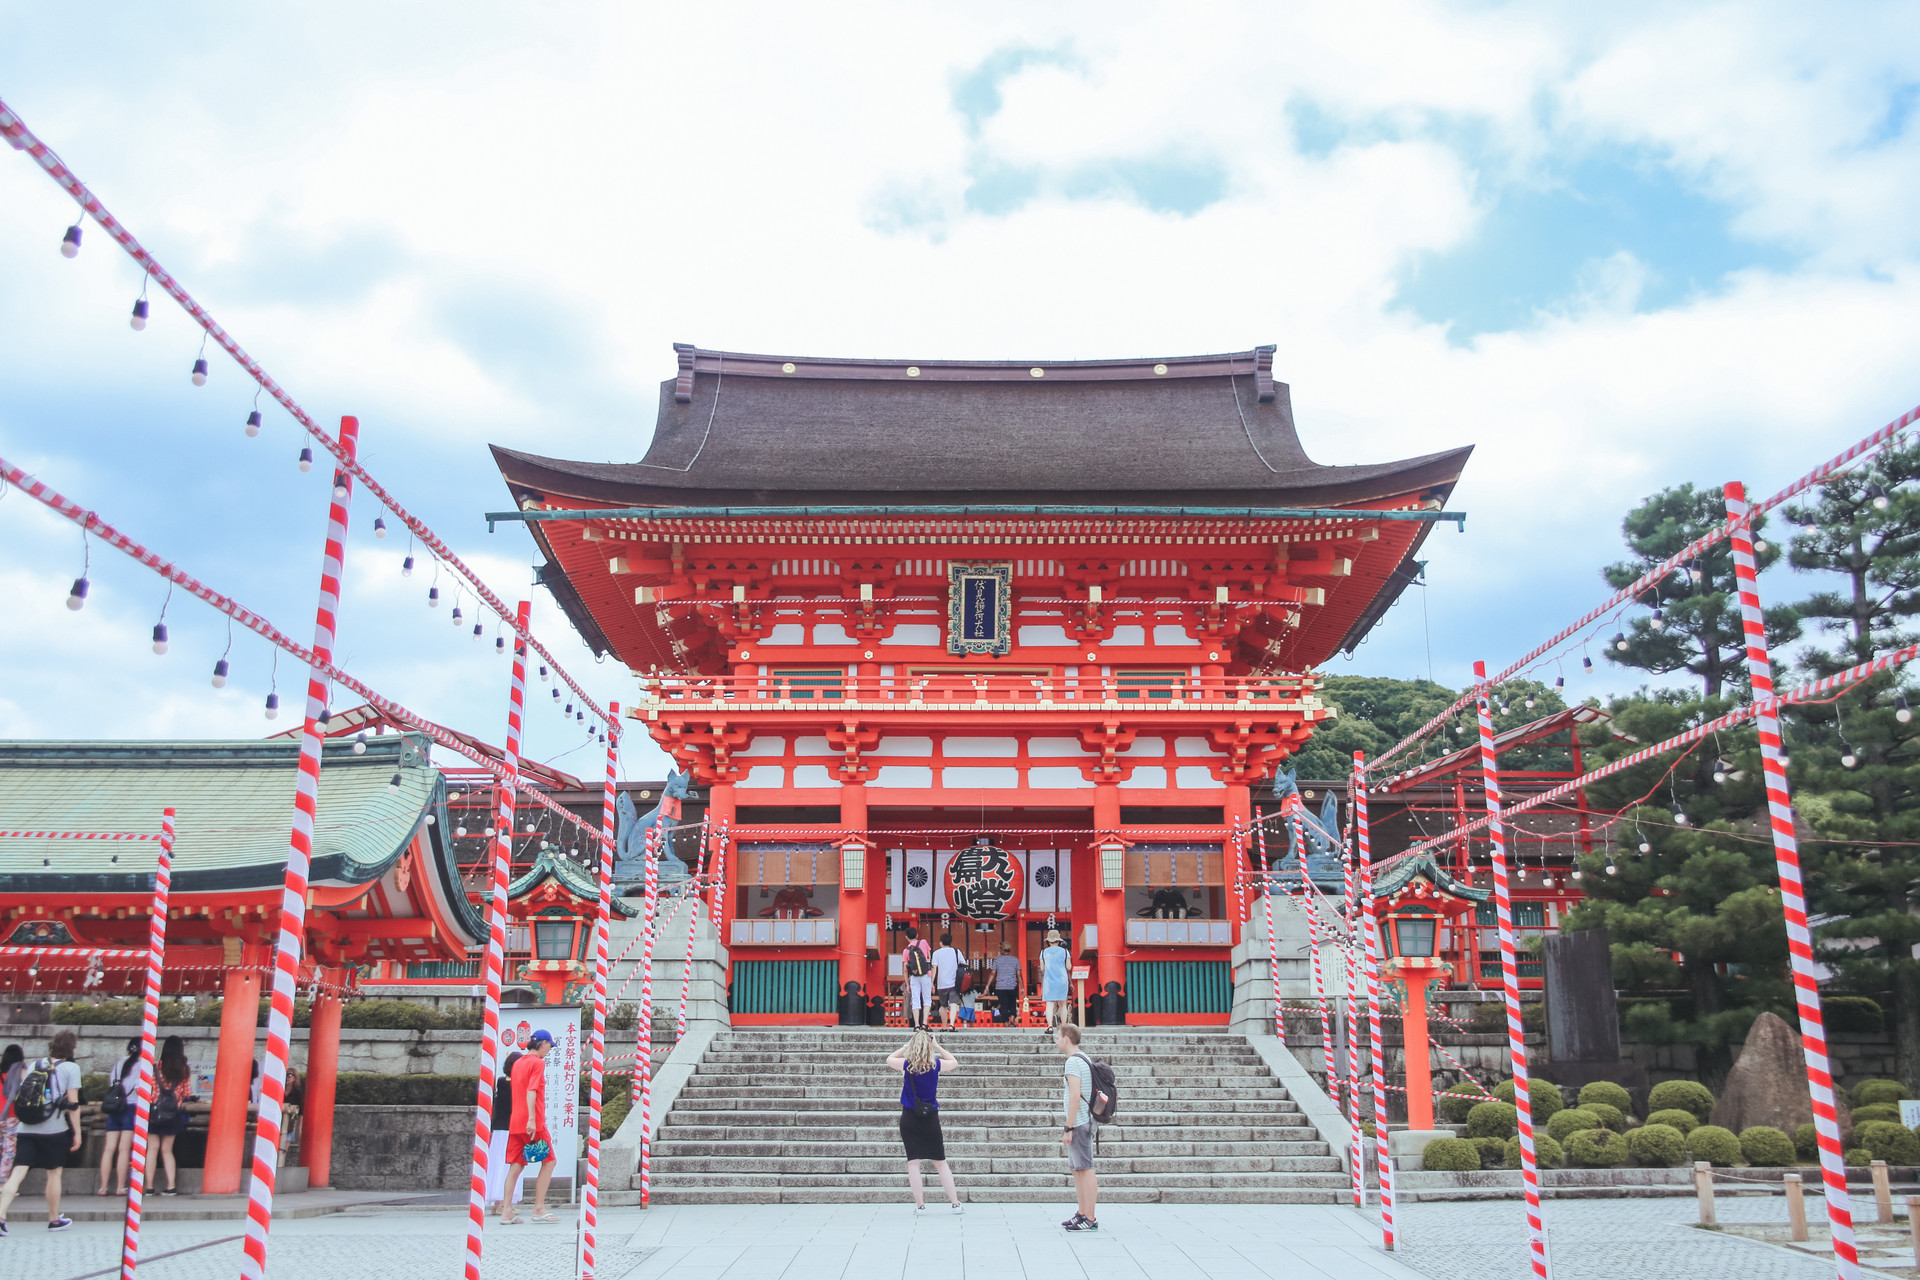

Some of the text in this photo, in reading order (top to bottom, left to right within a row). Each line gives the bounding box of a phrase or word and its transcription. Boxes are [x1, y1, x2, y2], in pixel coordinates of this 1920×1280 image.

[563, 1022, 577, 1128] 本宮祭献灯のご案内
